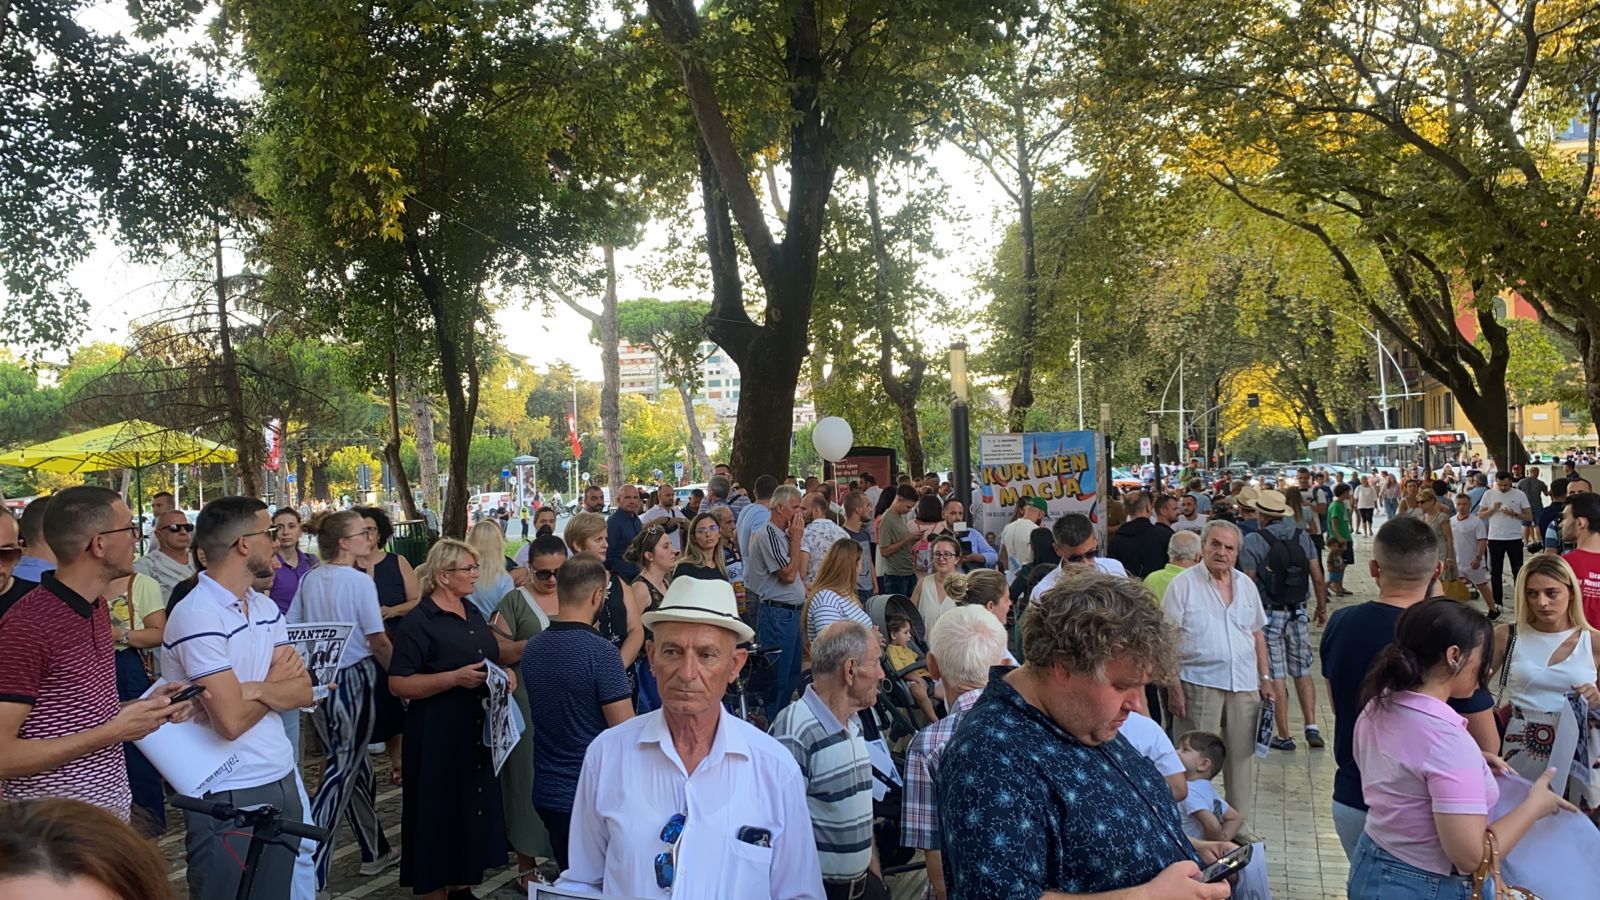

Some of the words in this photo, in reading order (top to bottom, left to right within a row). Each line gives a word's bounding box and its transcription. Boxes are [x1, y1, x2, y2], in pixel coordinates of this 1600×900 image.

[982, 463, 1030, 485] KUR
[1032, 452, 1089, 478] IKEN
[1000, 477, 1083, 507] MACJA
[287, 628, 337, 641] WANTED
